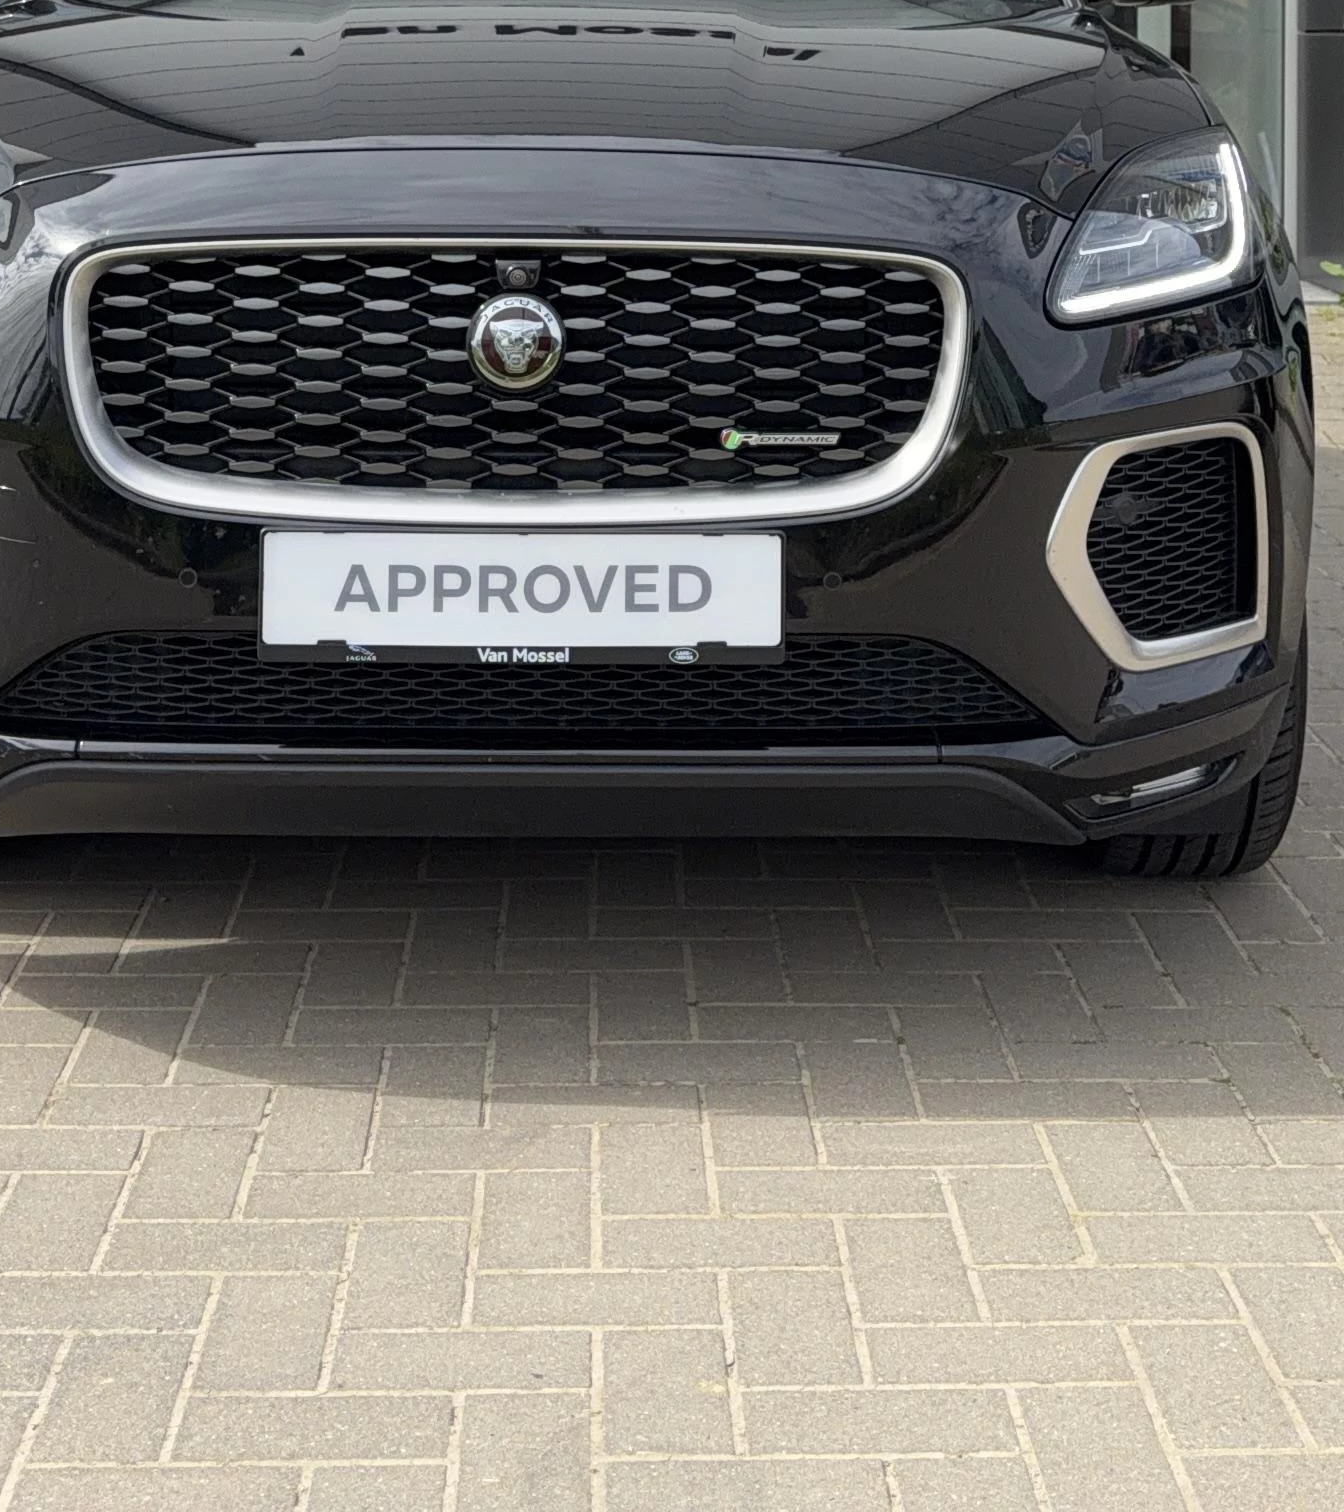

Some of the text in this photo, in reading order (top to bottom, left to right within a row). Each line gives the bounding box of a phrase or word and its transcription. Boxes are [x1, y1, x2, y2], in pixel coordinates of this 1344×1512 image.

[479, 298, 554, 323] JAGUAR
[333, 563, 713, 614] APPROVED
[476, 647, 570, 663] Van Mossel
